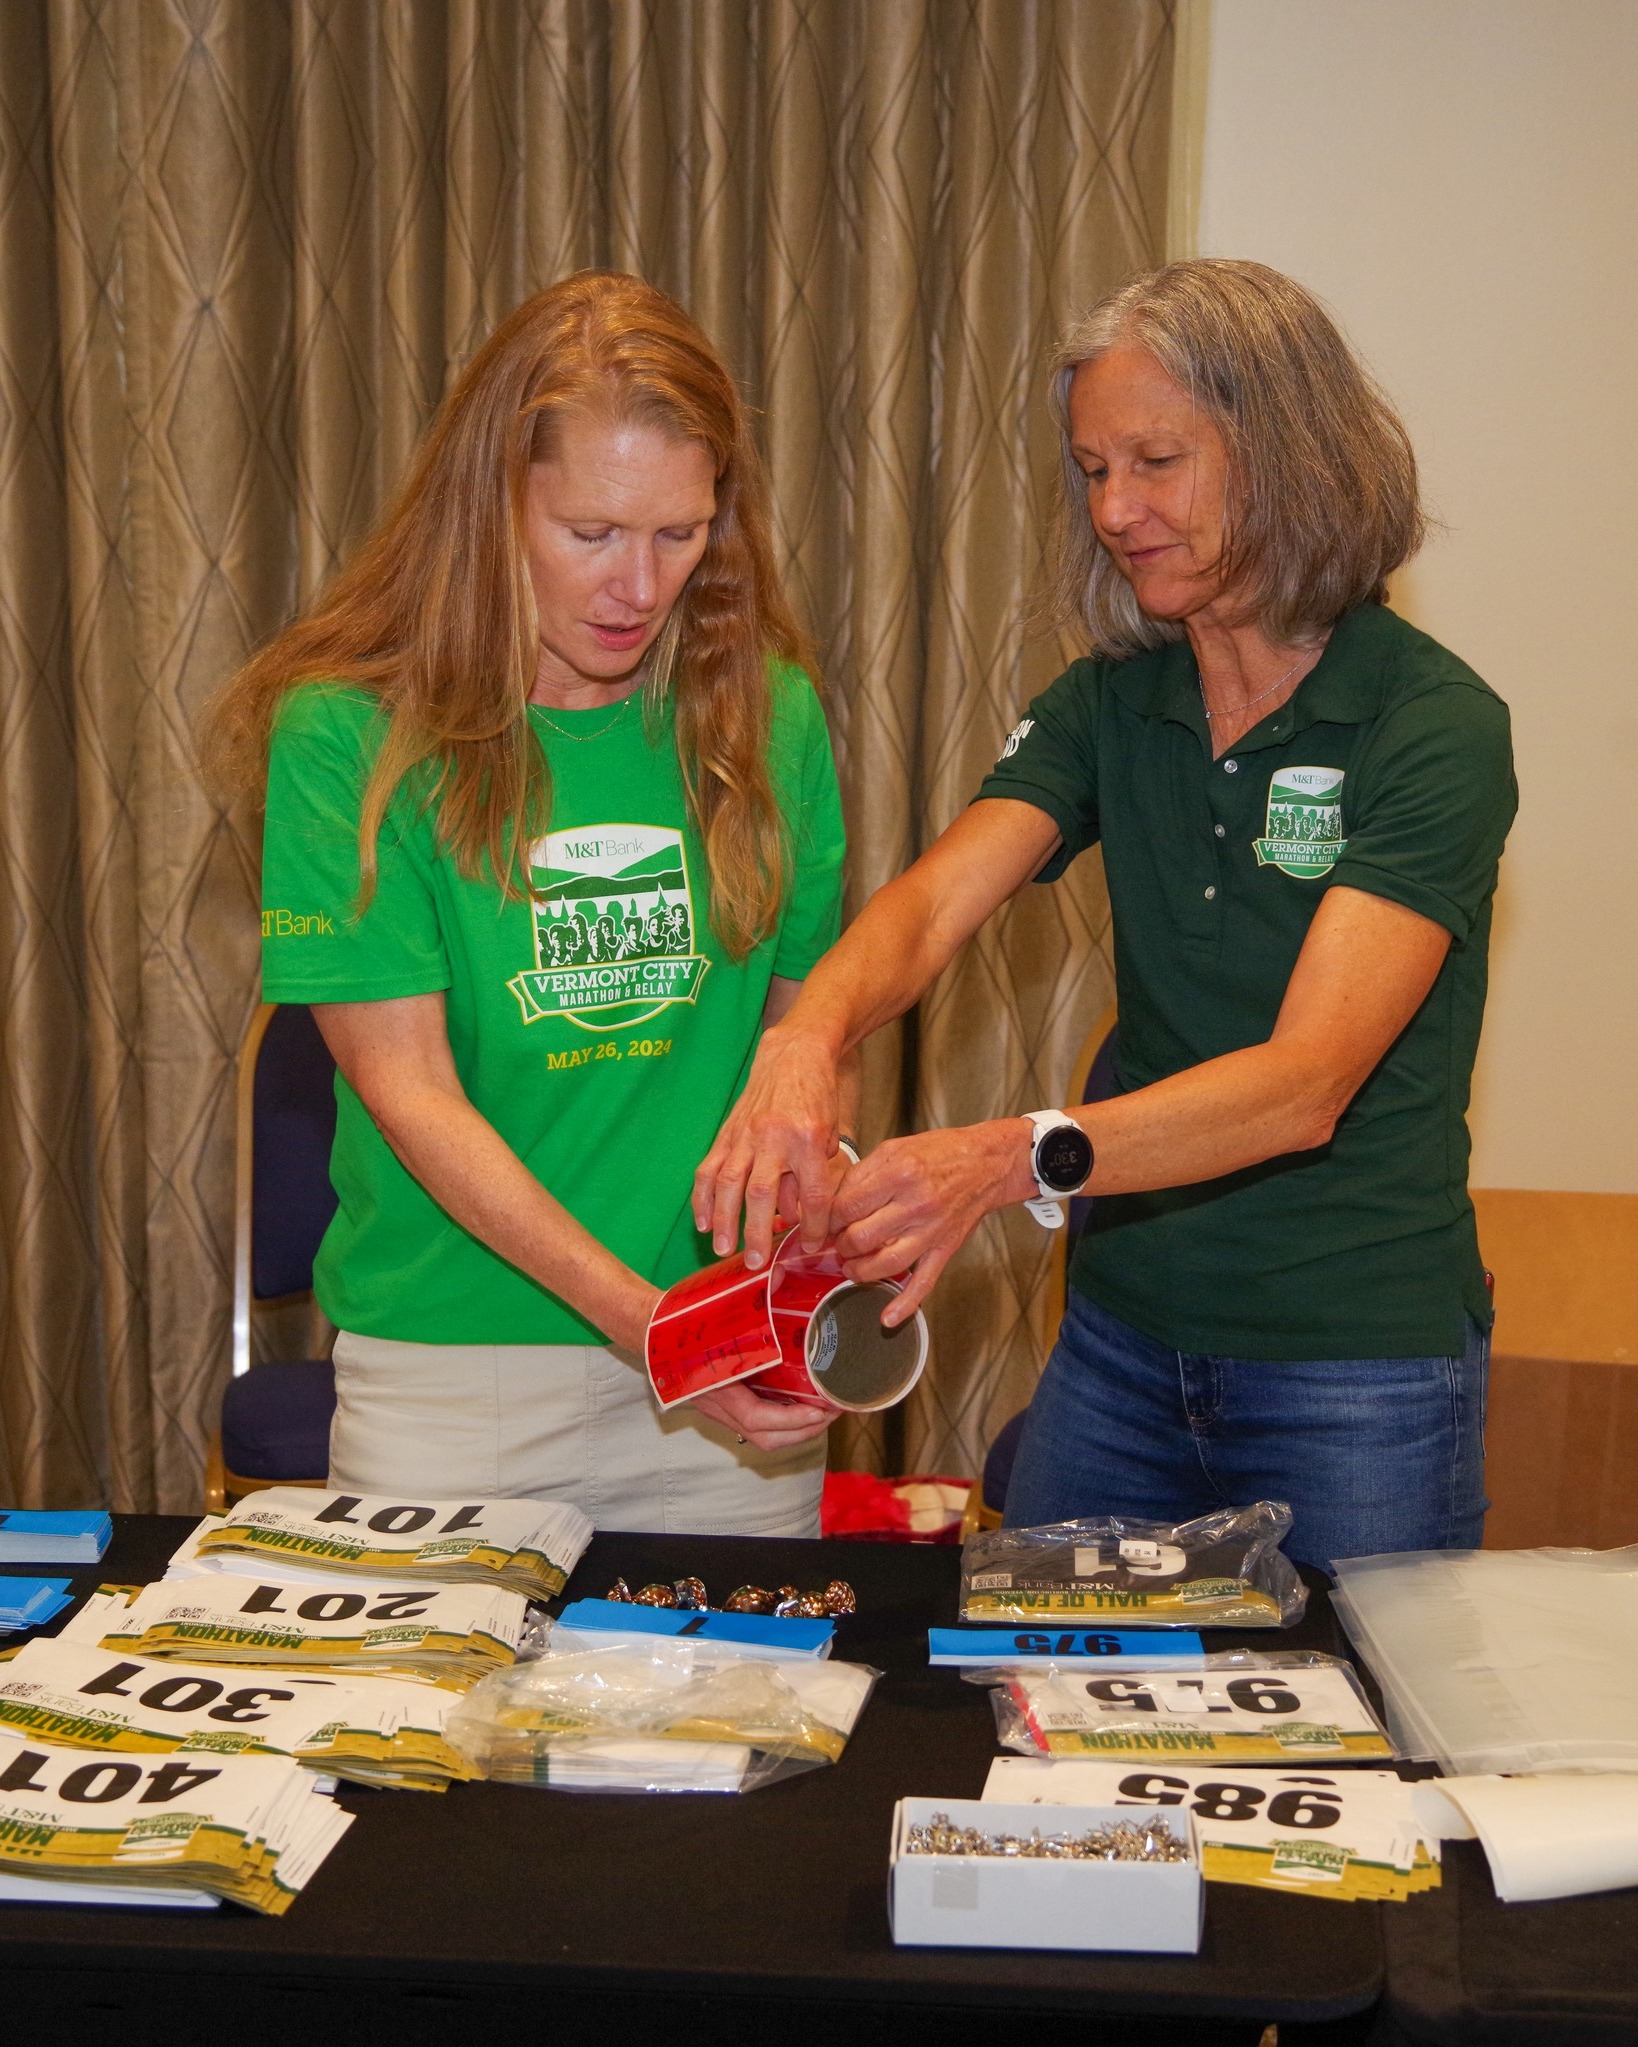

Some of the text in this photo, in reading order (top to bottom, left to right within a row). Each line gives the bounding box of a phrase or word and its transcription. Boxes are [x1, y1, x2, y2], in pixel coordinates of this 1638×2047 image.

[1291, 774, 1334, 785] M&T Bank
[564, 838, 645, 859] M&T Bank
[1264, 842, 1342, 855] VERMONT CITY
[1274, 853, 1310, 863] MARATHON
[1318, 855, 1334, 863] RELAY
[277, 909, 334, 936] Bank
[534, 962, 694, 994] VERMONT CITY
[559, 982, 674, 1007] MARATHON & RELAY
[547, 1039, 673, 1070] MAY 26, 2024
[313, 1495, 485, 1534] 101
[245, 1529, 365, 1561] MARATHON
[283, 1523, 370, 1546] M&T Bank
[1018, 1582, 1114, 1591] M&T Bank
[238, 1585, 440, 1621] 201
[989, 1594, 1147, 1608] HALL OF FAME
[171, 1625, 304, 1650] MARATHON
[209, 1616, 306, 1634] M&T Bank
[1014, 1634, 1122, 1656] 975
[77, 1662, 295, 1723] 301
[40, 1695, 135, 1724] M&T Bank
[1079, 1731, 1216, 1750] MARATHON
[0, 1750, 223, 1804] 401
[1115, 1774, 1343, 1829] 985
[4, 1808, 63, 1823] M&T
